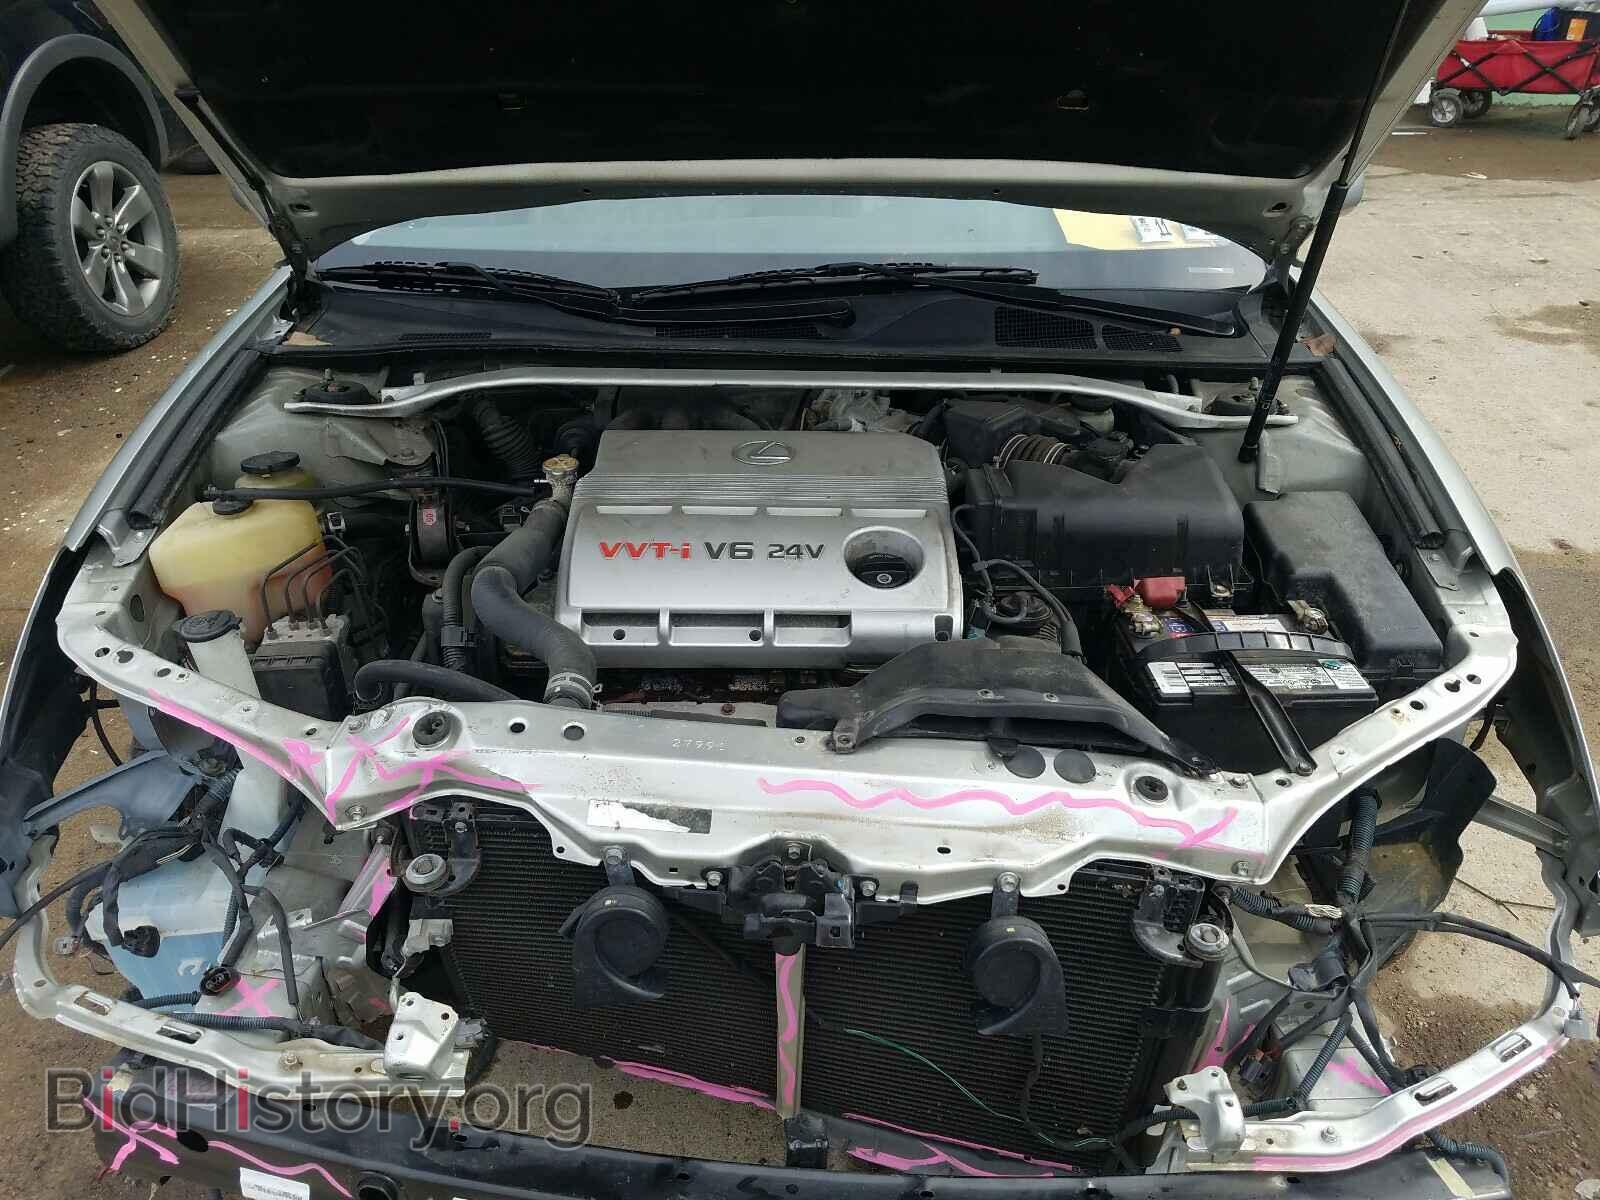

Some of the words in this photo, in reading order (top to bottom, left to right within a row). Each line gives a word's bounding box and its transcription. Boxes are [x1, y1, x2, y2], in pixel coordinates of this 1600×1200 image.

[599, 541, 692, 560] VVT-i
[704, 541, 755, 560] V6
[767, 543, 826, 560] 24V
